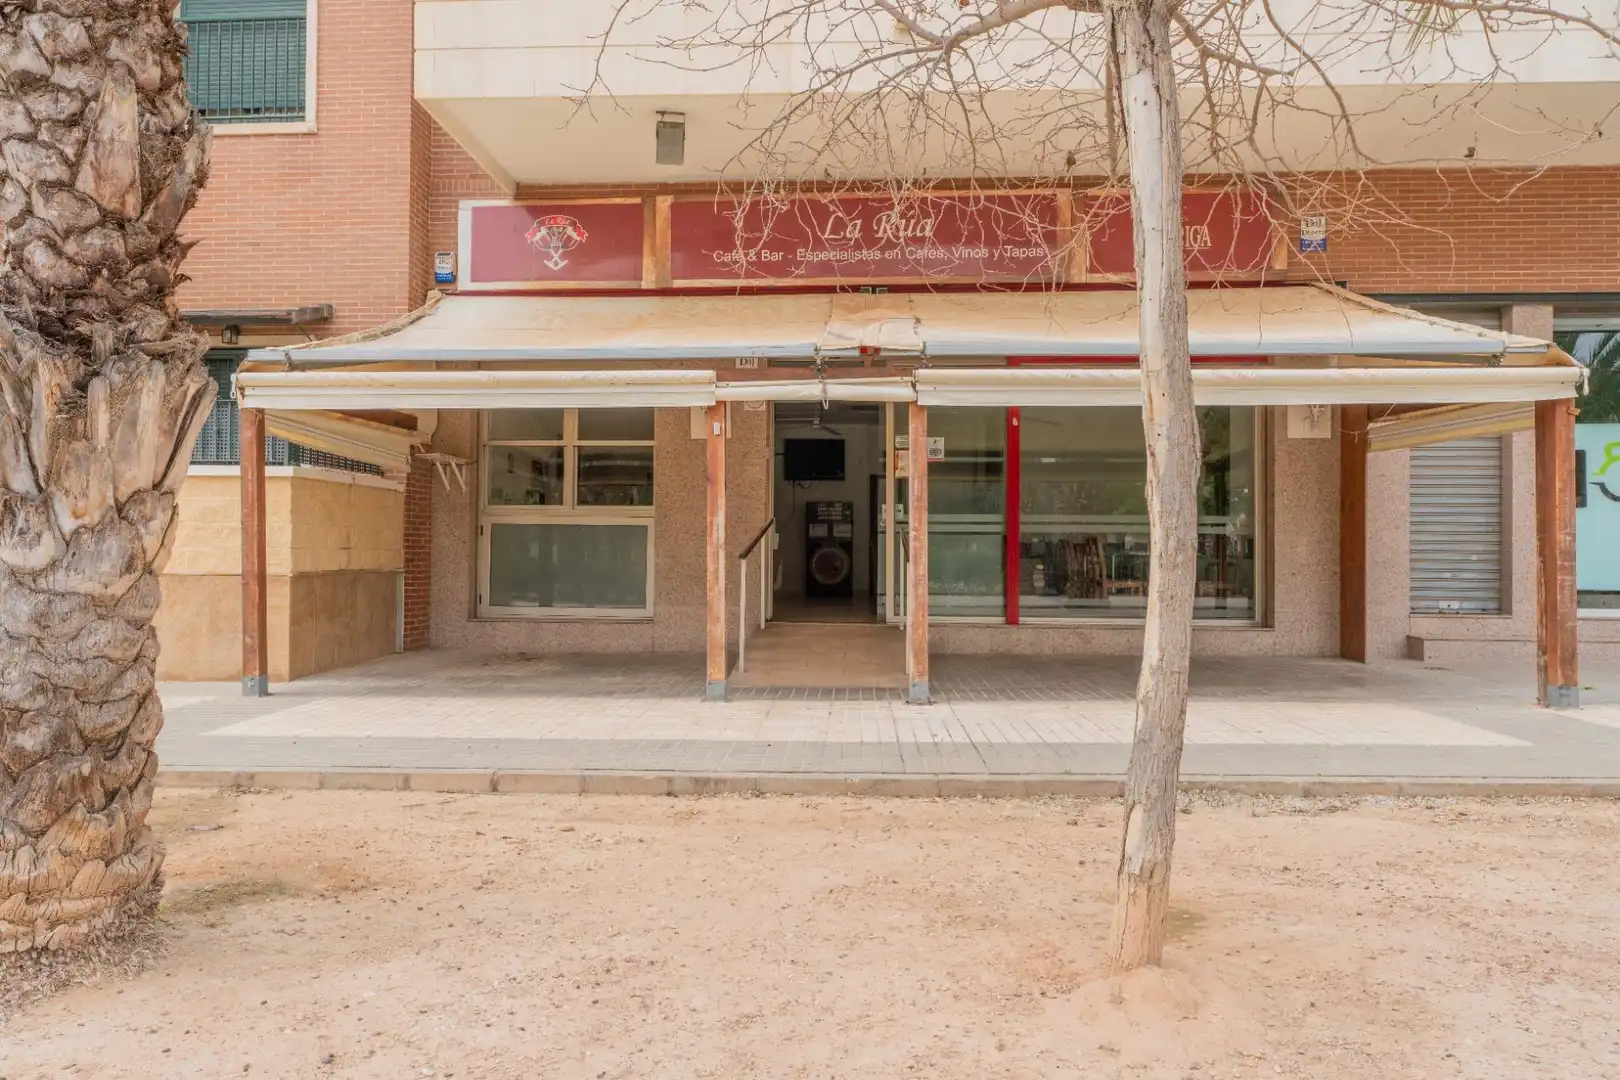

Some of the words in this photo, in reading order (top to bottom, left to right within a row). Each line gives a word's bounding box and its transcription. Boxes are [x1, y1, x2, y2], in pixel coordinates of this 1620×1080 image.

[823, 212, 862, 239] La
[747, 249, 757, 261] &
[761, 249, 785, 262] Bar
[796, 248, 881, 262] Especialistas
[884, 249, 901, 260] en
[952, 246, 989, 259] Vinos
[993, 248, 1001, 261] y
[1003, 245, 1044, 260] Tapas
